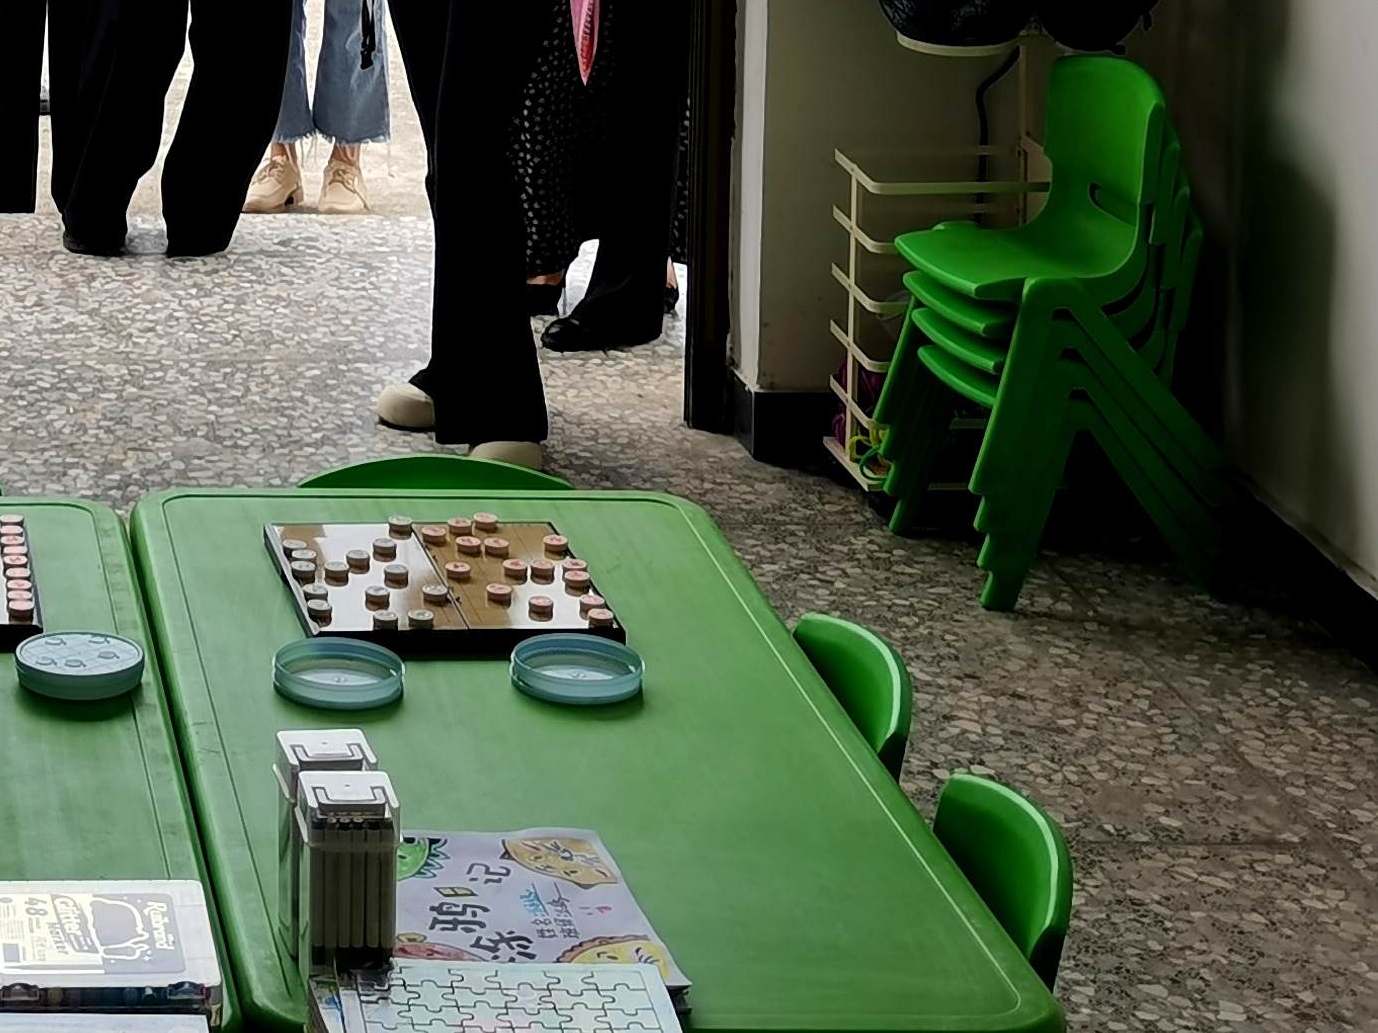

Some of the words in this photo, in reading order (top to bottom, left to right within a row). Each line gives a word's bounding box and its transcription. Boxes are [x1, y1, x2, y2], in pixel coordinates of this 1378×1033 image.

[24, 897, 49, 916] 48
[53, 897, 82, 936] Glitter
[428, 861, 538, 963] 涂鸦日记
[45, 922, 69, 955] Marker
